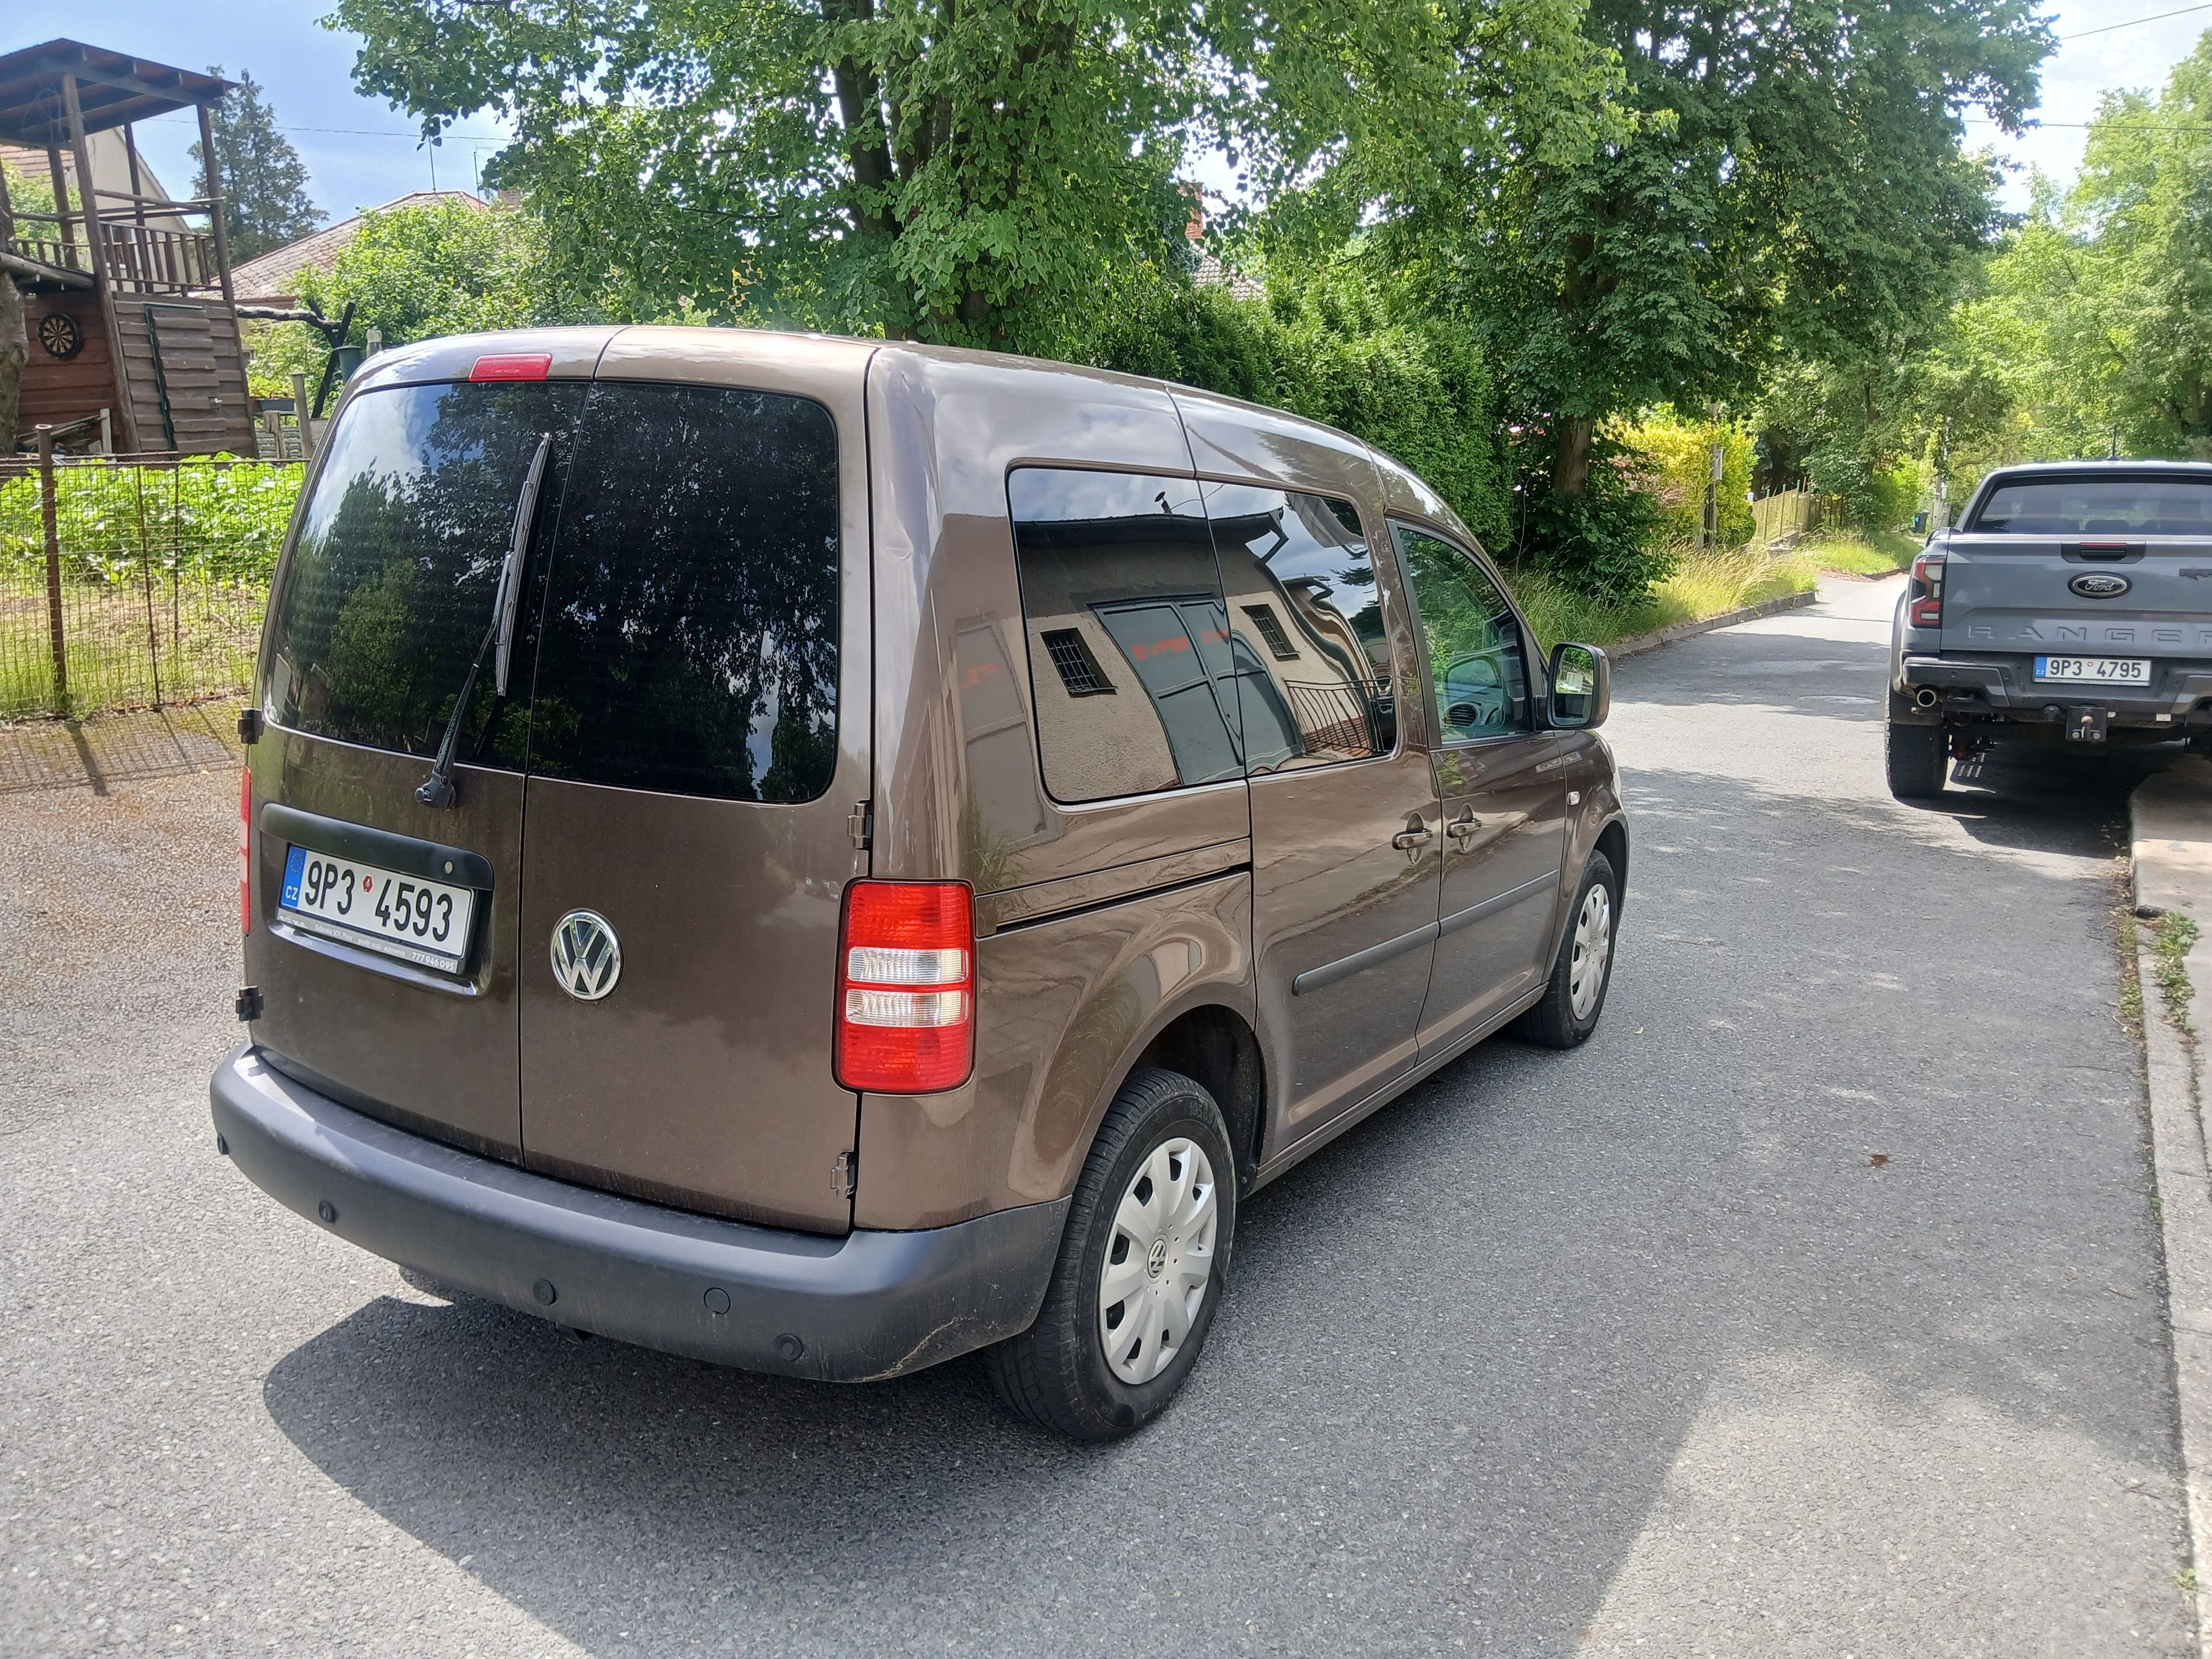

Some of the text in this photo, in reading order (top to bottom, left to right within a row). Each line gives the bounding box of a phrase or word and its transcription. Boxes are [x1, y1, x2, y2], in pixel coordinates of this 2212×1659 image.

[2085, 579, 2114, 591] Ford
[2050, 659, 2142, 678] 9P3 4795
[285, 885, 299, 901] CZ
[305, 860, 453, 942] 9P3 4593
